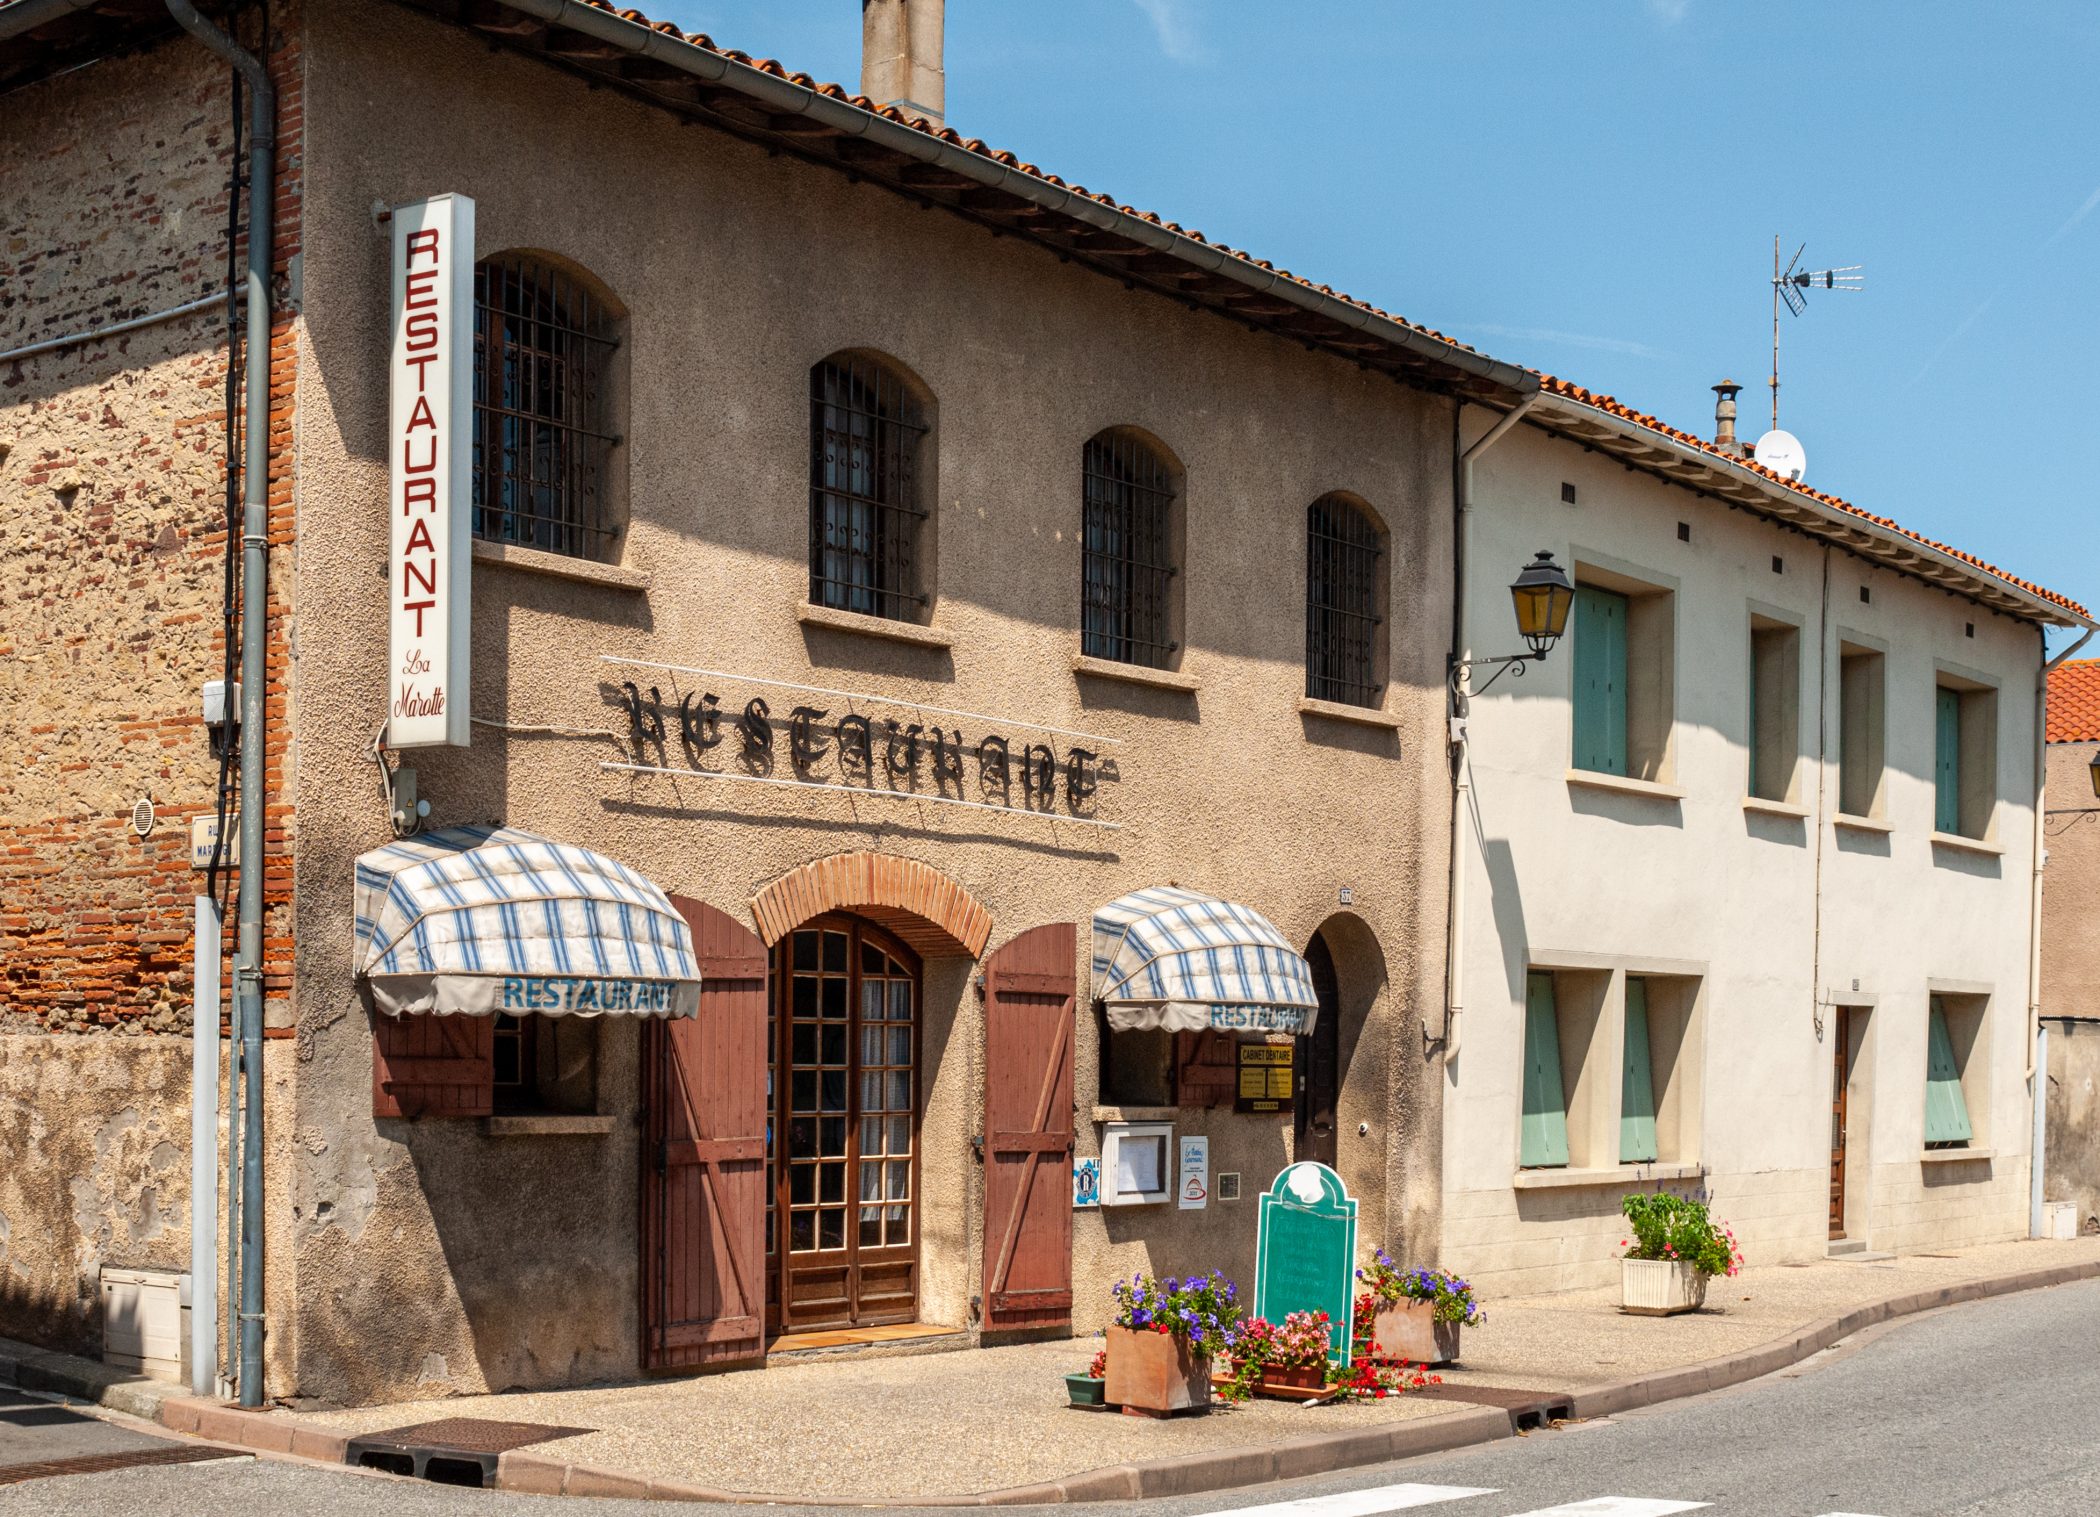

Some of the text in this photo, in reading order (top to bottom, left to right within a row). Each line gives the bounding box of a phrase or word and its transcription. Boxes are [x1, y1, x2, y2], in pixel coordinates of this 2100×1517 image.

[404, 228, 439, 637] RESTAURANT
[403, 649, 430, 675] La
[394, 681, 445, 718] Marotte
[197, 844, 231, 857] MARGO
[504, 977, 676, 1010] RESTAURANT
[1242, 1049, 1291, 1061] CABINET DENTAIRE
